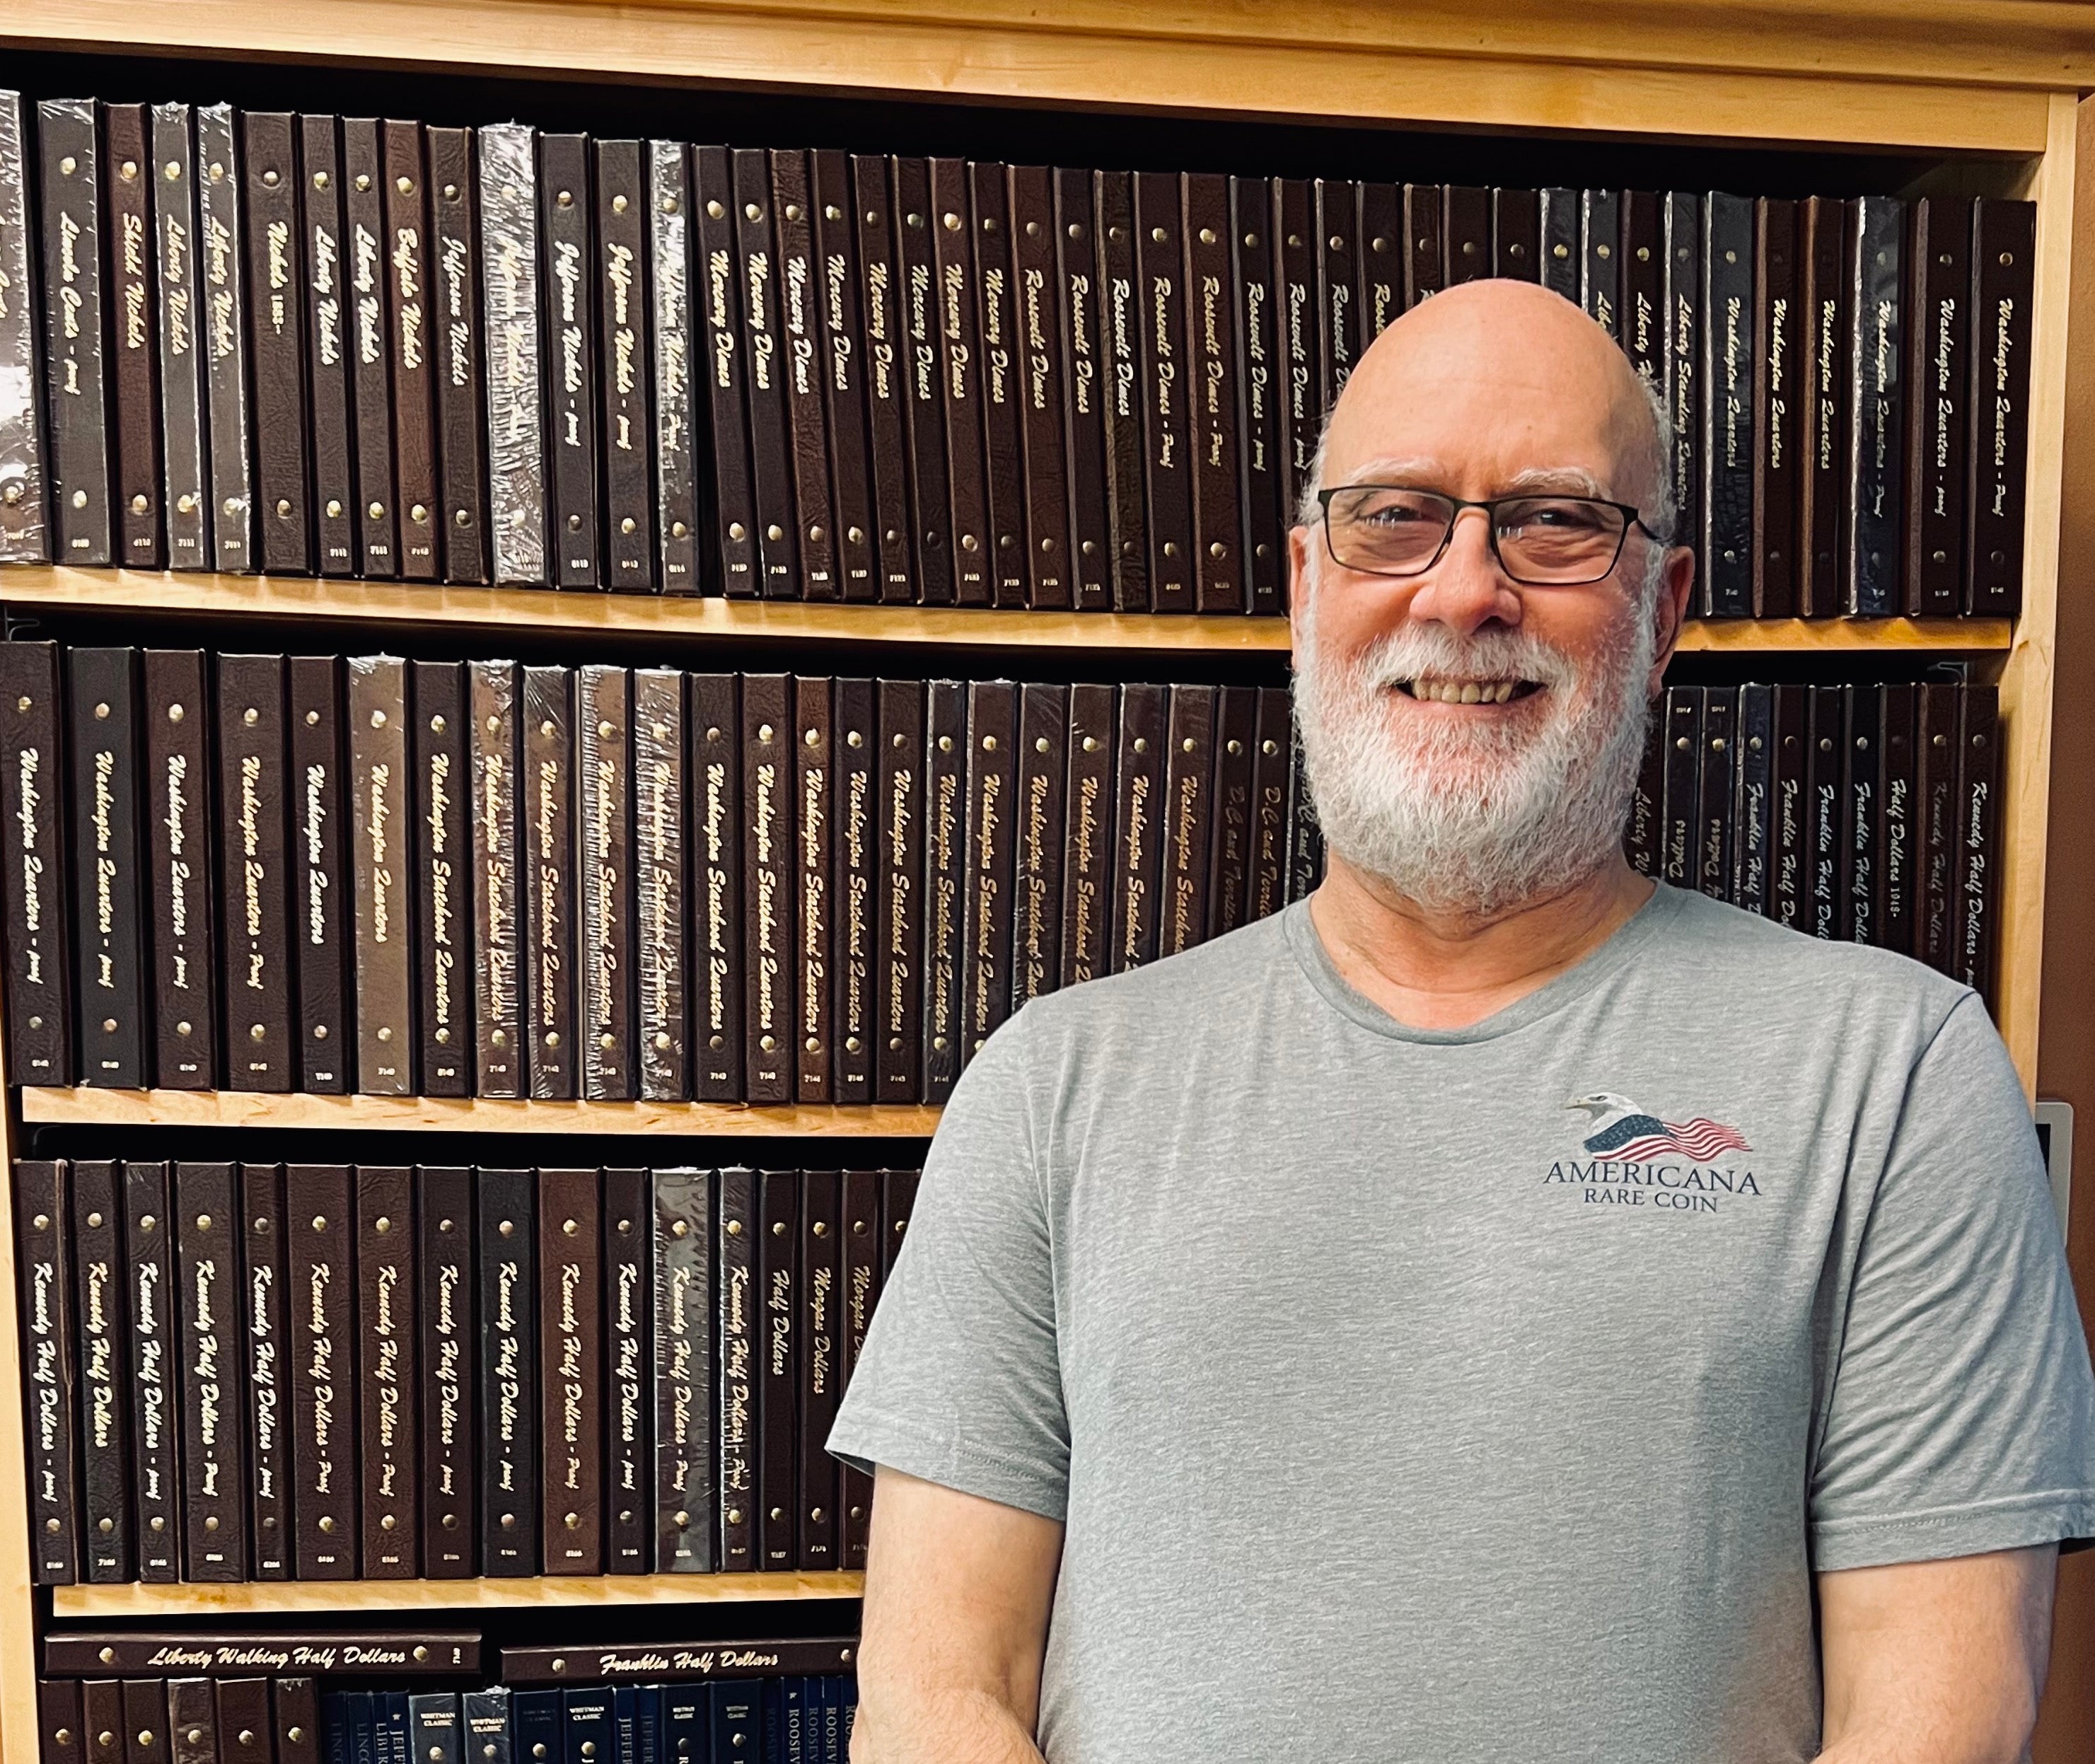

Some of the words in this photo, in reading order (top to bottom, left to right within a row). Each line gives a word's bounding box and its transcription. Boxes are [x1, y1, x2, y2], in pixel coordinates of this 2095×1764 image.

[61, 211, 80, 282] Lincoln
[123, 213, 142, 275] Shield
[164, 214, 186, 283] Liberty
[206, 216, 231, 284] Liberty
[267, 221, 288, 289] Nickels
[313, 226, 336, 294] Liberty
[354, 224, 376, 292] Liberty
[393, 228, 419, 297] Buffalo
[442, 237, 466, 316] Jefferson
[60, 286, 82, 338] Cents
[125, 282, 145, 348] Nickels
[555, 241, 579, 321] Jefferson
[608, 243, 632, 324] Jefferson
[710, 250, 729, 327] Mercury
[749, 253, 767, 330] Mercury
[788, 257, 806, 334] Mercury
[828, 255, 845, 330] Mercury
[986, 269, 1003, 344] Mercury
[1025, 269, 1045, 349] Roosevelt
[1072, 274, 1089, 354] Roosevelt
[169, 289, 188, 354] Nickels
[211, 291, 233, 356] Nickels
[318, 298, 339, 365] Nickels
[358, 297, 379, 363] Nickels
[401, 303, 422, 369] Nickels
[1113, 279, 1131, 358] Roosevelt
[1154, 277, 1172, 356] Roosevelt
[1290, 283, 1306, 361] Roosevelt
[1676, 294, 1692, 355] Liberty
[1724, 298, 1740, 390] Washington
[1768, 299, 1786, 390] Washington
[1934, 298, 1954, 390] Washington
[1993, 298, 2013, 390] Washington
[450, 322, 469, 385] Nickels
[562, 327, 582, 392] Nickels
[615, 328, 634, 393] Nickels
[716, 332, 733, 387] Dimes
[755, 334, 772, 389] Dimes
[794, 339, 812, 394] Dimes
[834, 336, 850, 390] Dimes
[992, 349, 1008, 402] Dimes
[1032, 355, 1048, 408] Dimes
[1076, 361, 1092, 413] Dimes
[1117, 363, 1133, 415] Dimes
[1159, 362, 1174, 414] Dimes
[1293, 367, 1308, 418] Dimes
[1672, 360, 1691, 434] Standing
[1728, 396, 1740, 467] Quarters
[1772, 398, 1784, 468] Quarters
[1937, 398, 1952, 467] Quarters
[1995, 396, 2010, 465] Quarters
[17, 748, 40, 849] Washington
[91, 751, 114, 851] Washington
[164, 755, 187, 854] Washington
[238, 757, 261, 856] Washington
[303, 765, 326, 864] Washington
[368, 764, 390, 862] Washington
[426, 753, 450, 852] Washington
[535, 760, 557, 858] Washington
[703, 764, 725, 861] Washington
[753, 765, 775, 862] Washington
[801, 769, 823, 867] Washington
[845, 771, 866, 867] Washington
[888, 770, 911, 865] Washington
[1782, 779, 1797, 847] Franklin
[1818, 785, 1834, 852] Franklin
[1855, 782, 1870, 849] Franklin
[1886, 779, 1906, 818] Half
[1967, 782, 1987, 847] Kennedy
[1777, 854, 1796, 893] Half
[1815, 859, 1832, 899] Half
[1852, 857, 1869, 896] Half
[1890, 824, 1905, 881] Dollars
[1965, 854, 1985, 893] Half
[24, 854, 42, 931] Quarters
[98, 858, 116, 933] Quarters
[172, 861, 190, 936] Quarters
[245, 860, 264, 936] Quarters
[310, 869, 327, 944] Quarters
[374, 868, 391, 942] Quarters
[433, 859, 452, 945] Statehood
[541, 865, 559, 949] Statehood
[708, 867, 726, 953] Statehood
[758, 869, 777, 953] Statehood
[806, 873, 823, 957] Statehood
[849, 874, 866, 956] Statehood
[892, 873, 909, 956] Statehood
[1967, 898, 1983, 954] Dollars
[436, 949, 453, 1023] Quarters
[542, 953, 559, 1026] Quarters
[710, 957, 727, 1029] Quarters
[760, 956, 777, 1029] Quarters
[806, 960, 823, 1033] Quarters
[849, 960, 865, 1032] Quarters
[891, 961, 908, 1031] Quarters
[1543, 1161, 1763, 1195] AMERICANA
[1584, 1189, 1644, 1205] RARE
[1654, 1192, 1717, 1212] COIN
[31, 1263, 52, 1334] Kennedy
[86, 1263, 108, 1333] Kennedy
[137, 1263, 158, 1334] Kennedy
[194, 1260, 215, 1330] Kennedy
[250, 1266, 272, 1336] Kennedy
[308, 1263, 330, 1333] Kennedy
[374, 1266, 397, 1335] Kennedy
[436, 1265, 458, 1334] Kennedy
[496, 1262, 517, 1331] Kennedy
[559, 1264, 580, 1332] Kennedy
[615, 1263, 637, 1332] Kennedy
[768, 1270, 789, 1311] Half
[811, 1267, 830, 1330] Morgan
[33, 1340, 56, 1383] Half
[87, 1338, 110, 1381] Half
[138, 1340, 161, 1383] Half
[195, 1335, 217, 1379] Half
[252, 1342, 274, 1385] Half
[308, 1337, 331, 1380] Half
[374, 1340, 397, 1381] Half
[435, 1340, 458, 1381] Half
[495, 1337, 518, 1379] Half
[559, 1337, 581, 1378] Half
[616, 1338, 638, 1379] Half
[773, 1317, 789, 1375] Dollars
[814, 1336, 830, 1393] Dollars
[40, 1388, 57, 1450] Dollars
[93, 1386, 112, 1447] Dollars
[144, 1387, 162, 1448] Dollars
[201, 1384, 219, 1444] Dollars
[258, 1389, 276, 1449] Dollars
[315, 1386, 332, 1445] Dollars
[381, 1387, 397, 1446] Dollars
[441, 1386, 458, 1444] Dollars
[501, 1382, 518, 1440] Dollars
[565, 1383, 582, 1441] Dollars
[622, 1383, 638, 1441] Dollars
[148, 1647, 212, 1669] Liberty
[216, 1647, 288, 1669] Walking
[293, 1647, 336, 1669] Half
[344, 1647, 405, 1664] Dollars
[600, 1654, 668, 1675] Franklin
[673, 1652, 714, 1673] Half
[720, 1651, 778, 1666] Dollars
